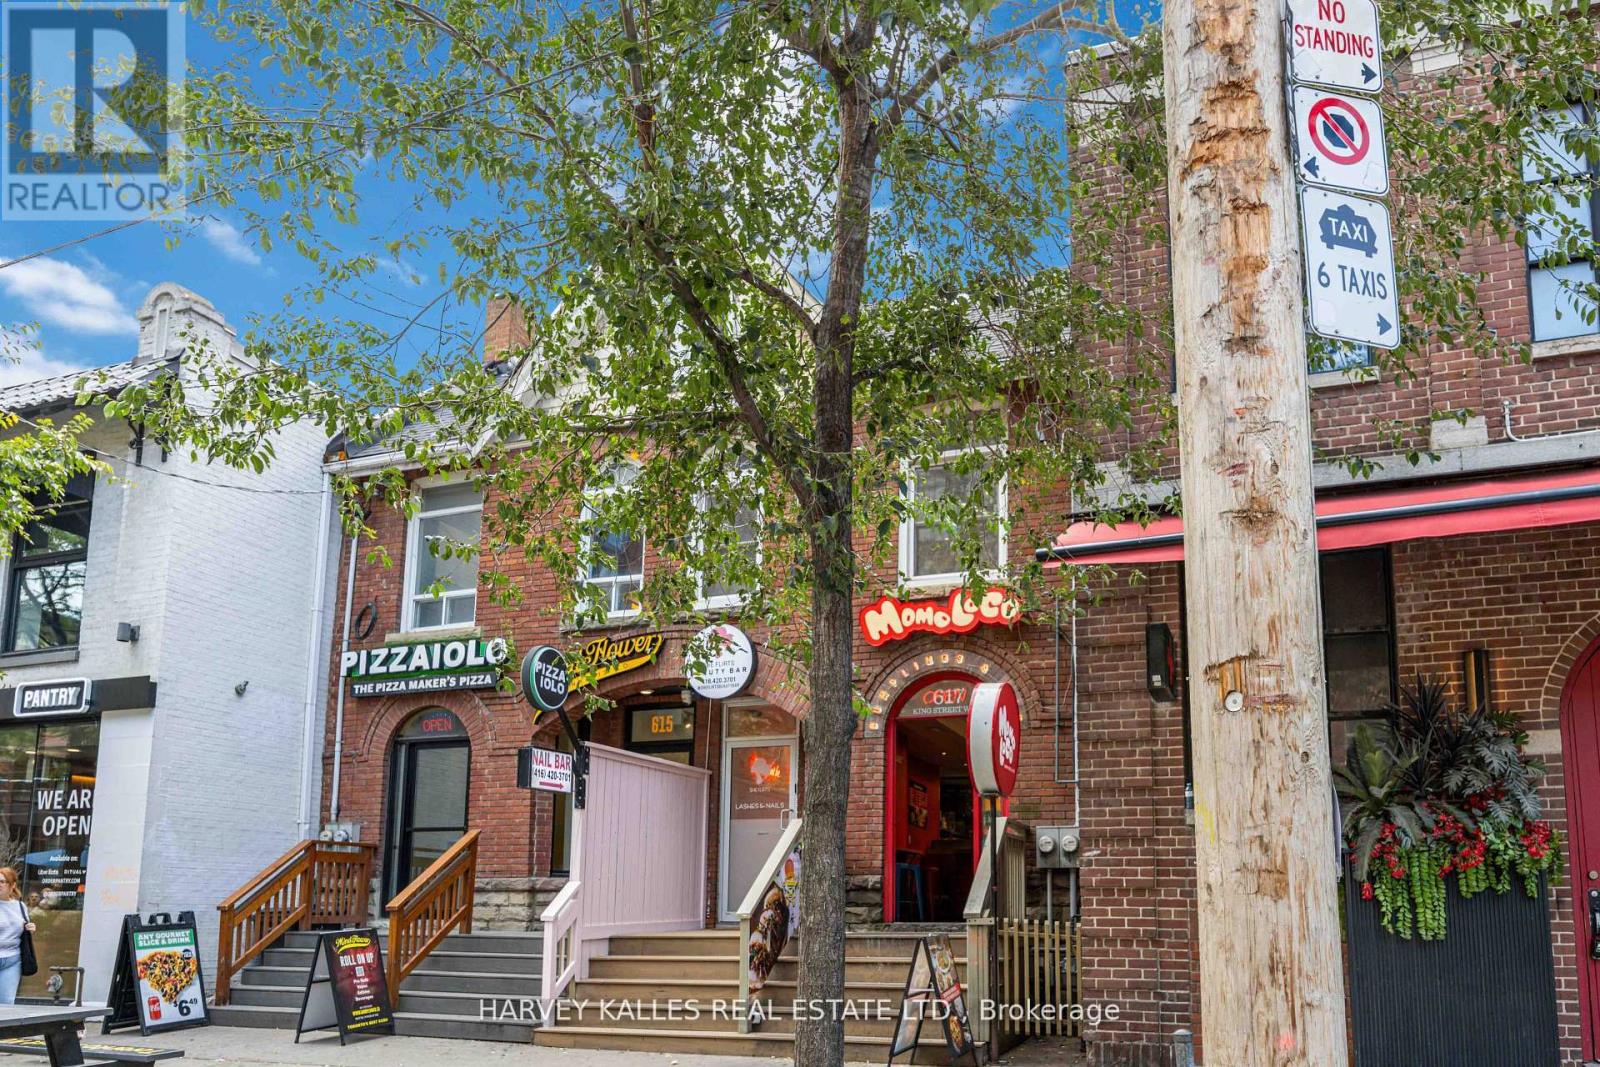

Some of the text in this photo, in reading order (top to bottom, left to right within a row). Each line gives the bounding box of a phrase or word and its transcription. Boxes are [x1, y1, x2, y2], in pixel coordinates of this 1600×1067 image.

[1318, 0, 1345, 24] NO
[1294, 24, 1374, 58] STANDING
[1327, 217, 1369, 243] TAXI
[1317, 262, 1388, 300] 6 TAXIS
[535, 660, 567, 684] PIZZA
[729, 666, 748, 674] BAR
[353, 674, 493, 695] THE PIZZA MAKER'S PIZZA
[540, 676, 566, 696] IOLO
[23, 686, 81, 709] PANTRY
[933, 688, 964, 705] 617
[913, 707, 932, 715] KING
[933, 705, 962, 714] STREET
[422, 718, 453, 732] OPEN
[651, 714, 674, 734] 615
[532, 750, 571, 770] NAIL BAR
[547, 769, 571, 783] 420-3701
[38, 788, 95, 810] WE AR
[42, 815, 92, 836] OPEN
[156, 930, 190, 939] GOURMET
[340, 955, 356, 967] ROLL
